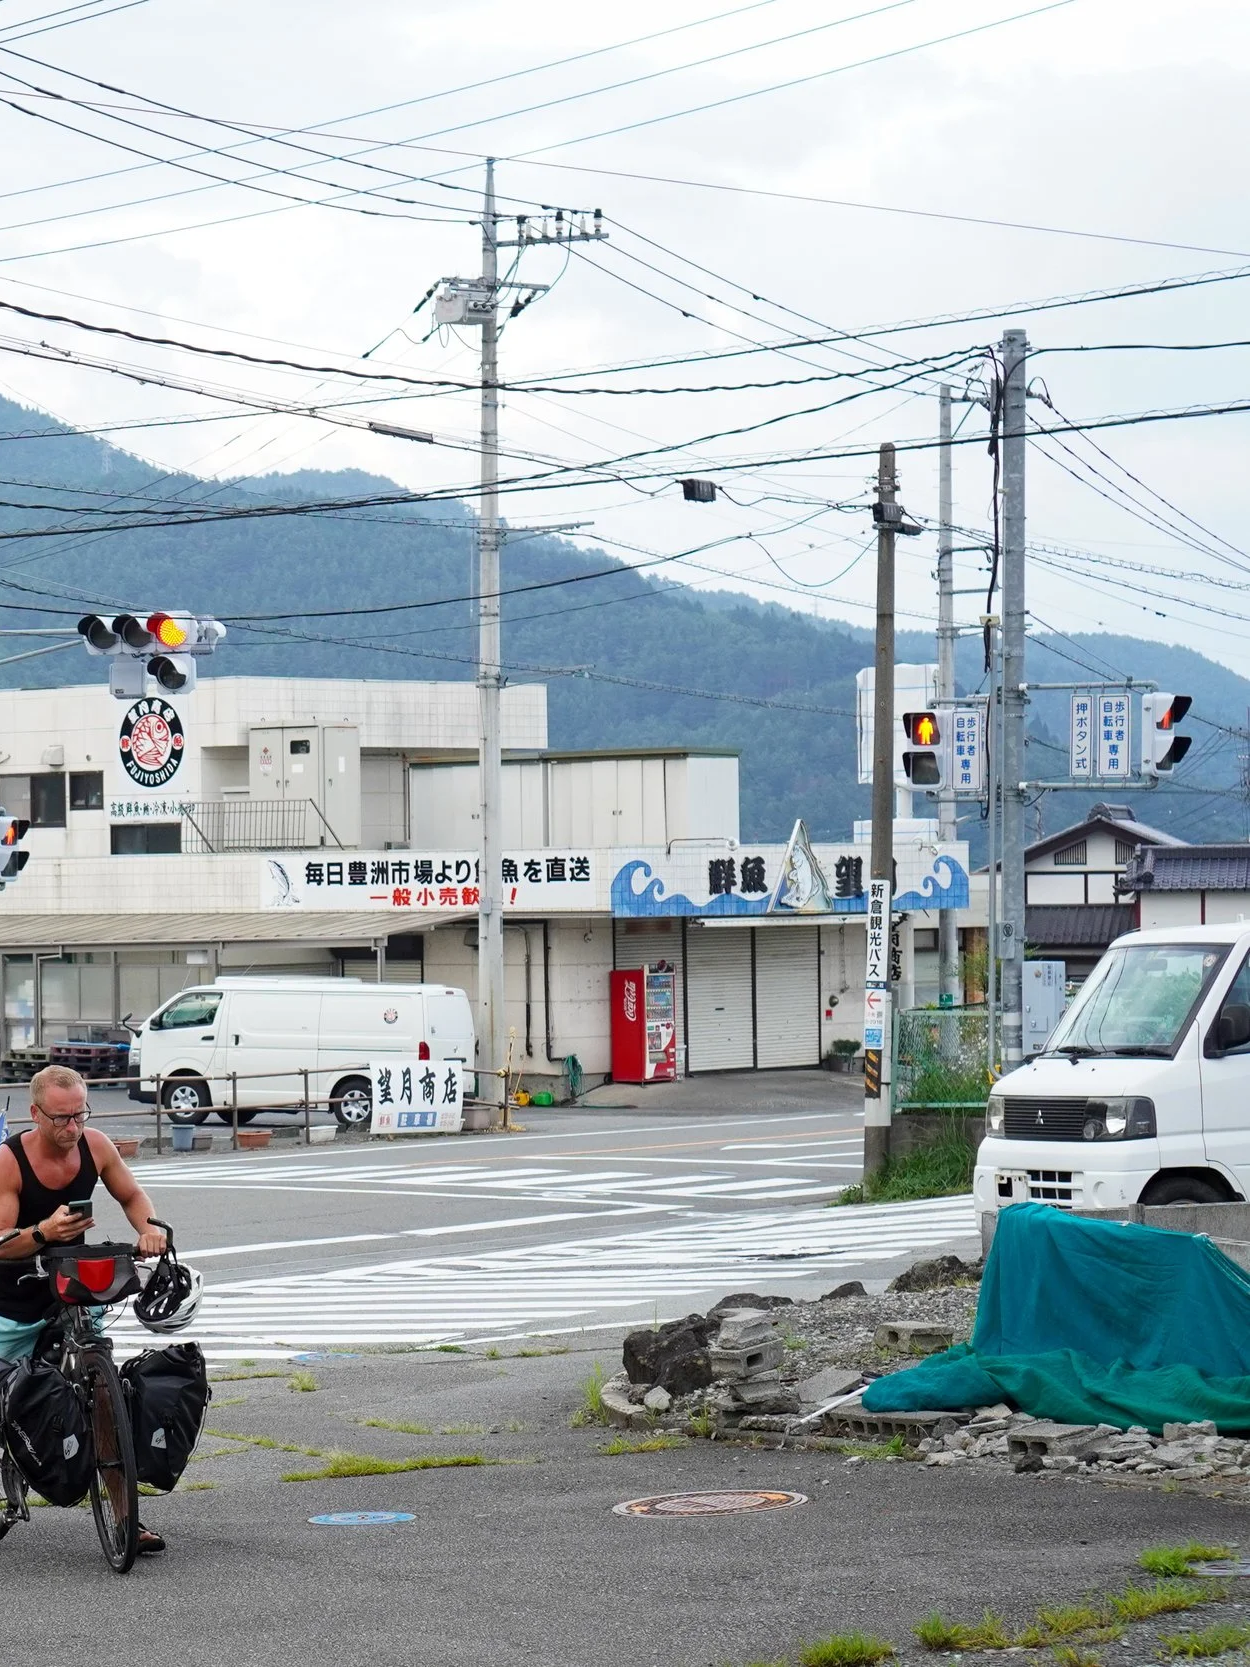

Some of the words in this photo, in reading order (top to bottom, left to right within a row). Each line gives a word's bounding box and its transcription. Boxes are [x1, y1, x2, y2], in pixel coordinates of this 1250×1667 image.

[956, 717, 965, 756] 自転車
[967, 717, 976, 756] 歩行者
[1076, 702, 1088, 770] 押ボタン式
[1102, 701, 1113, 741] 自転車
[1114, 701, 1125, 741] 歩行者
[126, 758, 178, 785] FUJIYOSHIDA
[961, 759, 971, 784] 専用
[1107, 744, 1119, 770] 専用
[305, 857, 590, 886] 毎日豊洲市場より魚を直送
[708, 856, 769, 896] 鮮魚
[370, 887, 517, 906] 一般小売歓！
[868, 883, 884, 977] 新倉観光バス
[377, 1066, 458, 1106] 望月商店
